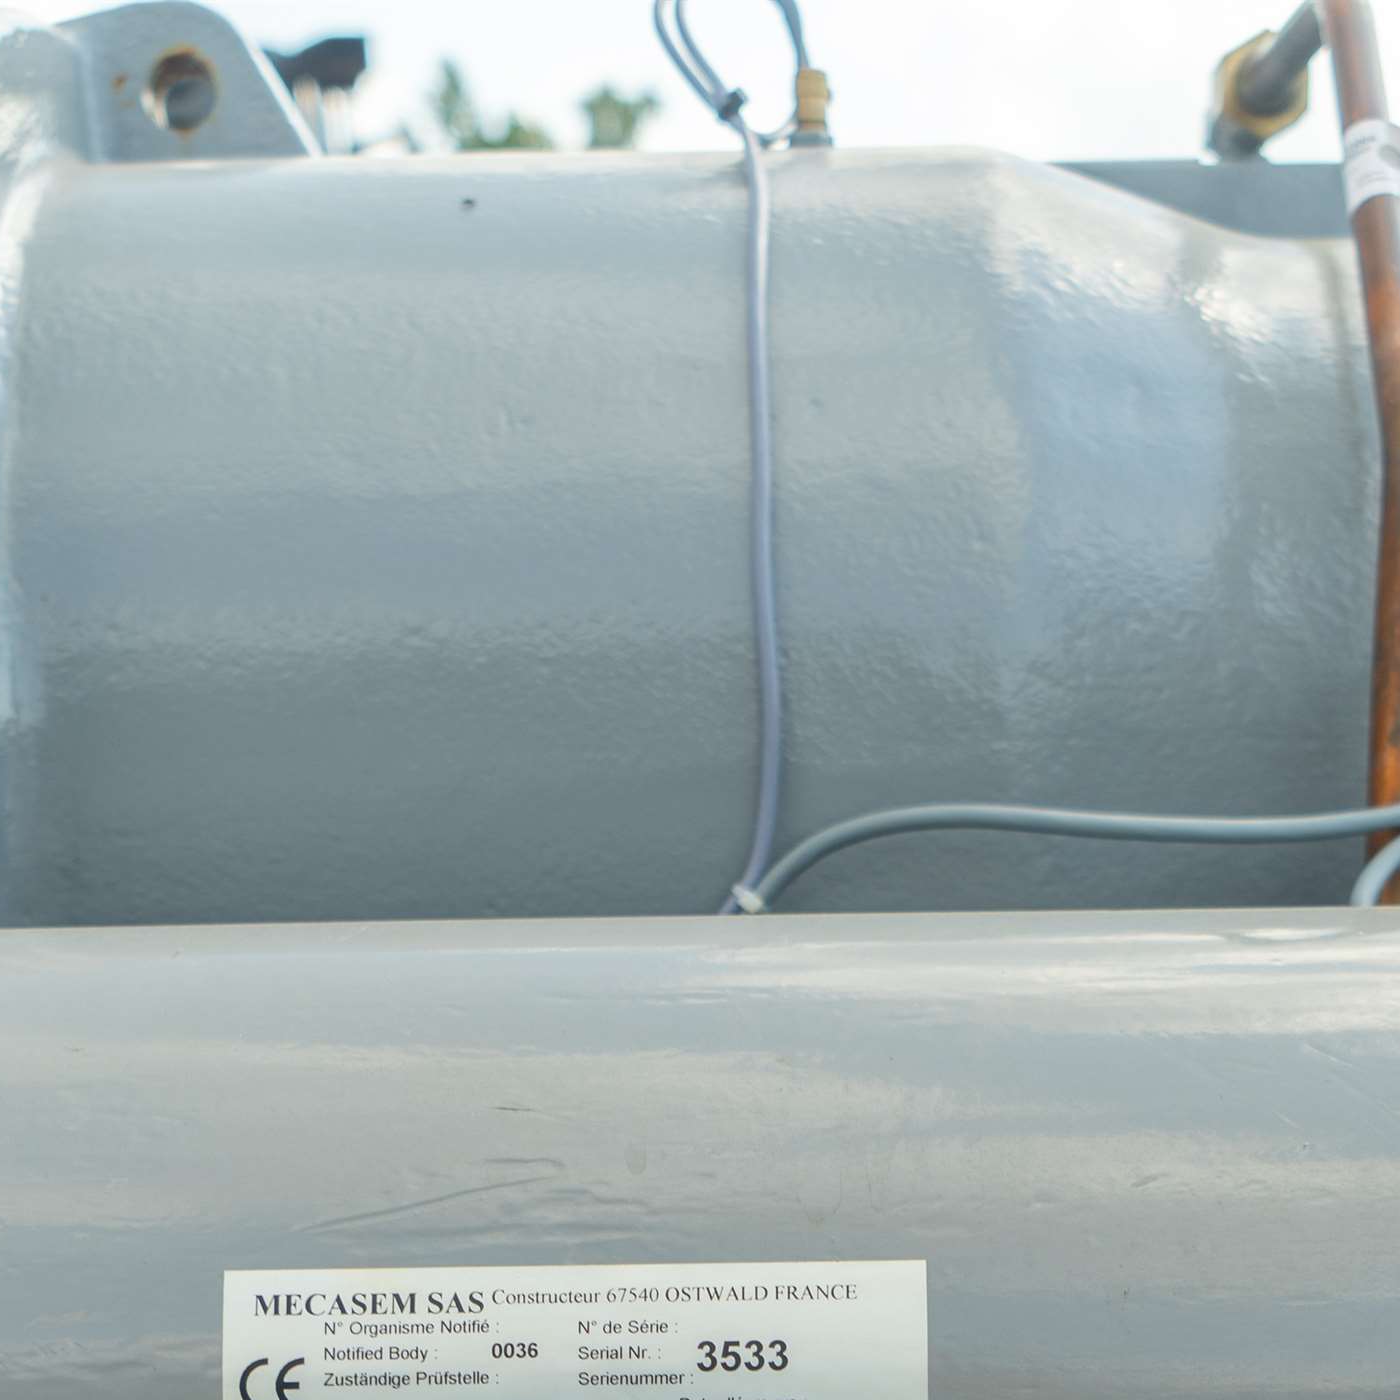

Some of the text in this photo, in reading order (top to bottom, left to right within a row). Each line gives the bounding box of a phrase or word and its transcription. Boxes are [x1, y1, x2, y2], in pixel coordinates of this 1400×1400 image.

[255, 1285, 857, 1316] MECASEM SAS Constructeur 67540 OSTWALD FRANCE
[325, 1321, 343, 1335] N°
[349, 1321, 434, 1338] Organisme
[441, 1320, 489, 1333] Notifié
[578, 1321, 597, 1334] N°
[603, 1320, 622, 1334] de
[628, 1320, 668, 1334] Série
[324, 1346, 383, 1360] Notified
[389, 1346, 428, 1362] Body
[492, 1343, 538, 1358] 0036
[578, 1346, 623, 1360] Serial
[629, 1346, 650, 1359] Nr.
[697, 1340, 788, 1372] 3533
[324, 1372, 410, 1389] Zuständige
[416, 1371, 489, 1385] Prüfstelle
[579, 1372, 685, 1386] Serienummer
